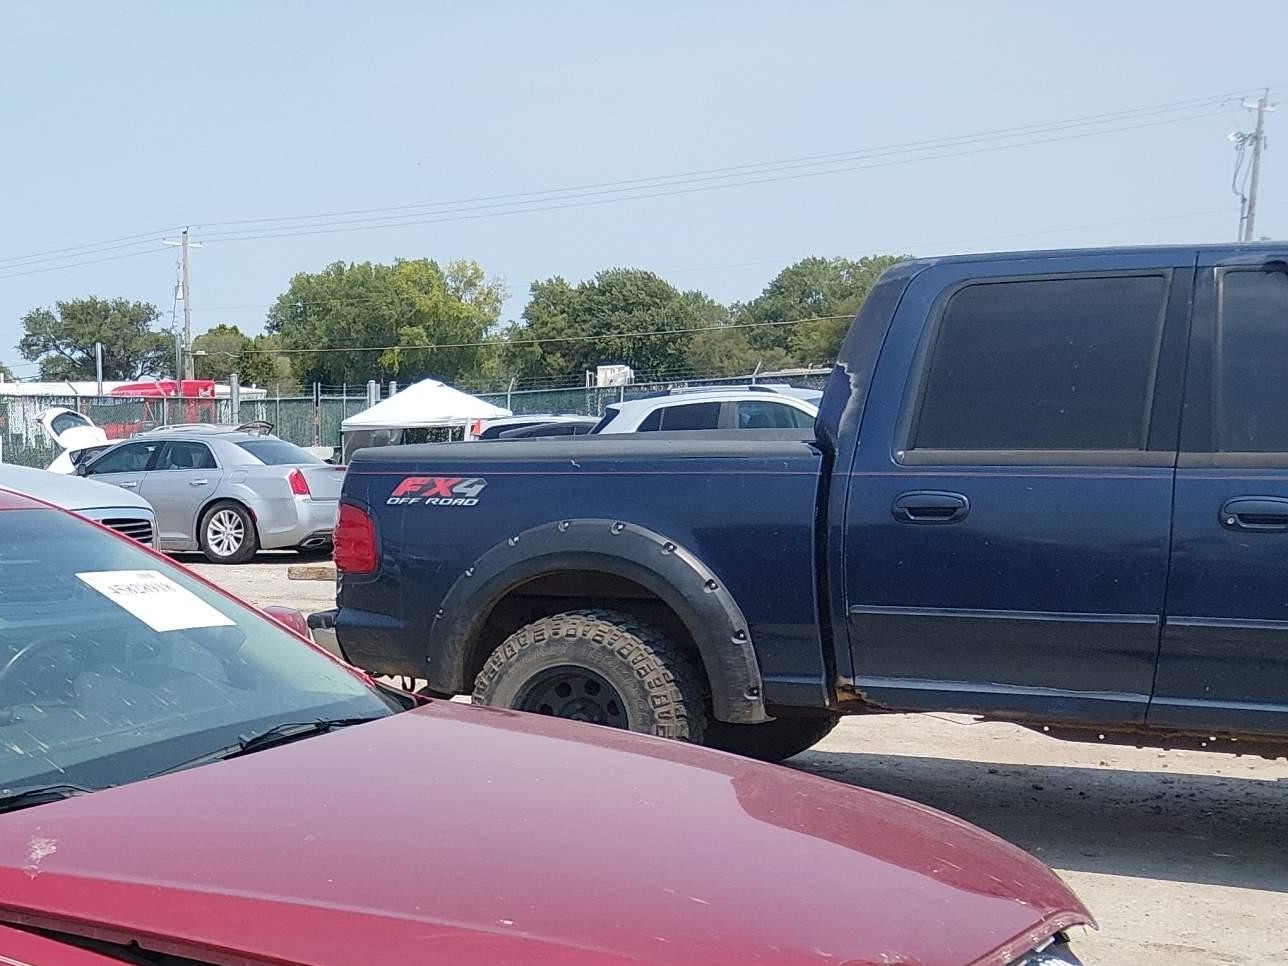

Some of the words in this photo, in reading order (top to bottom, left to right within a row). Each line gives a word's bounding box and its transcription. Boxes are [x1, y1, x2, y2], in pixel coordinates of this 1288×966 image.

[391, 476, 489, 497] FX4
[386, 497, 423, 505] OFF
[425, 498, 480, 506] ROAD
